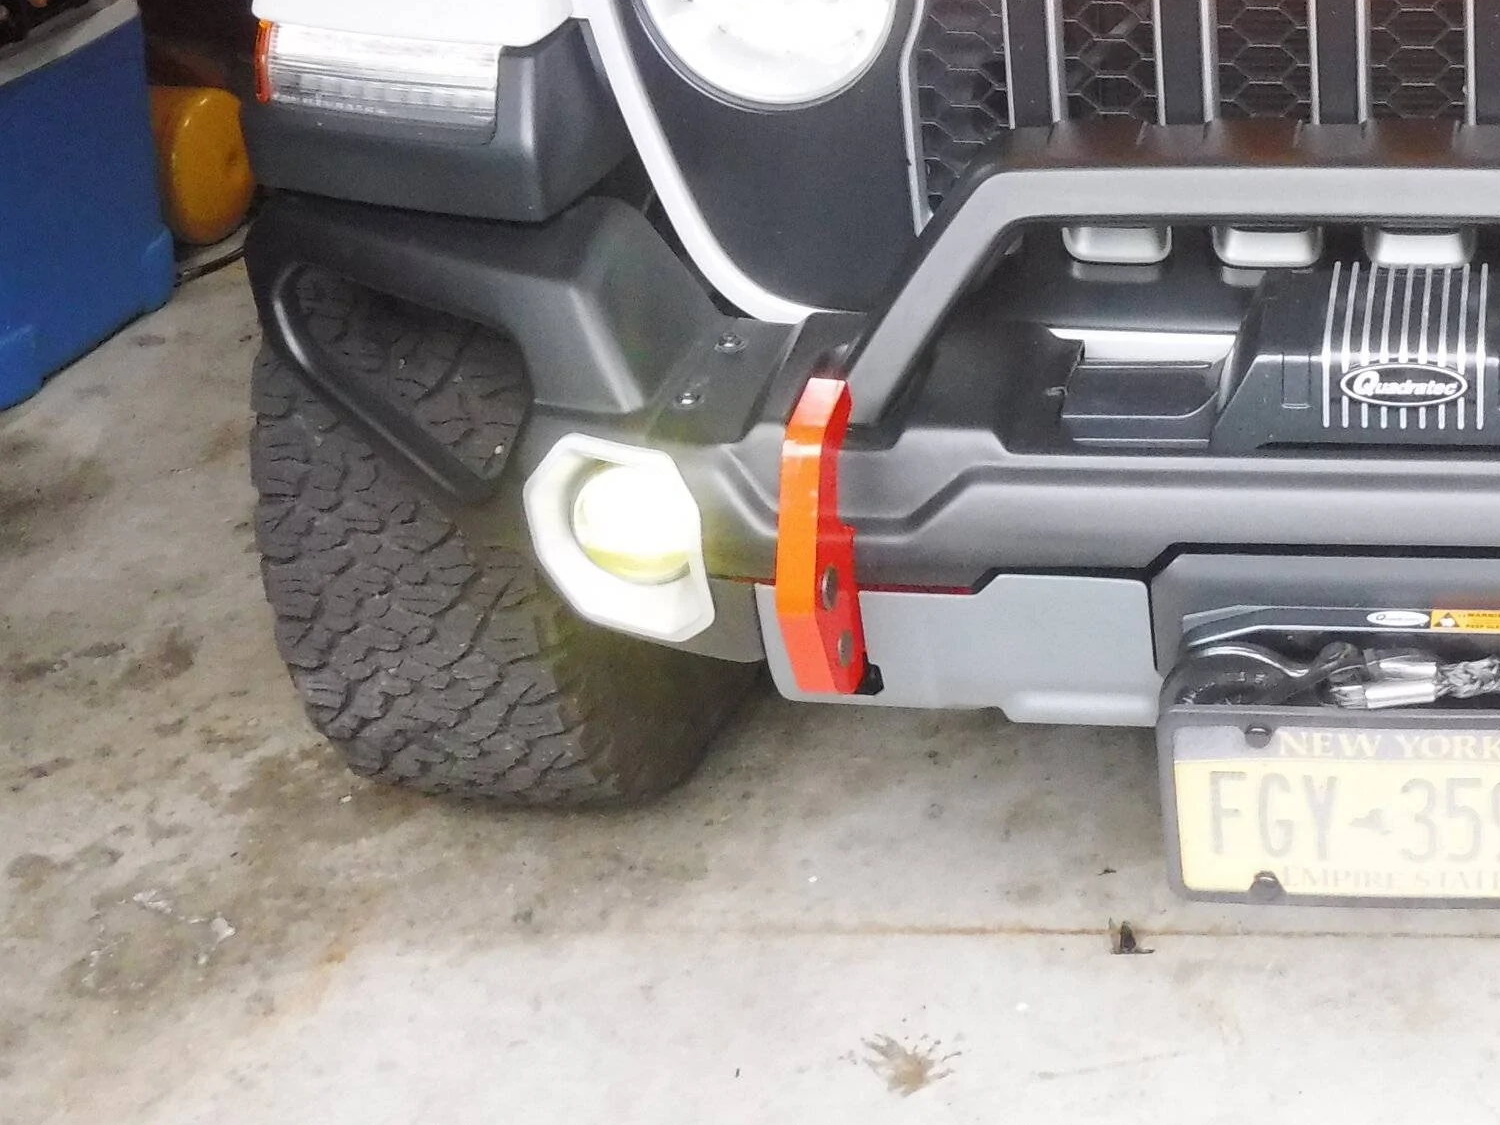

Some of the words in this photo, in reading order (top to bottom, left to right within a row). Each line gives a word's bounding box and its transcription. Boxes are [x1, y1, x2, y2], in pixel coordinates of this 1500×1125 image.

[1352, 370, 1459, 397] Quadratec
[1279, 731, 1380, 758] NEW
[1209, 770, 1338, 862] FGY
[1283, 865, 1400, 890] EMPIRE
